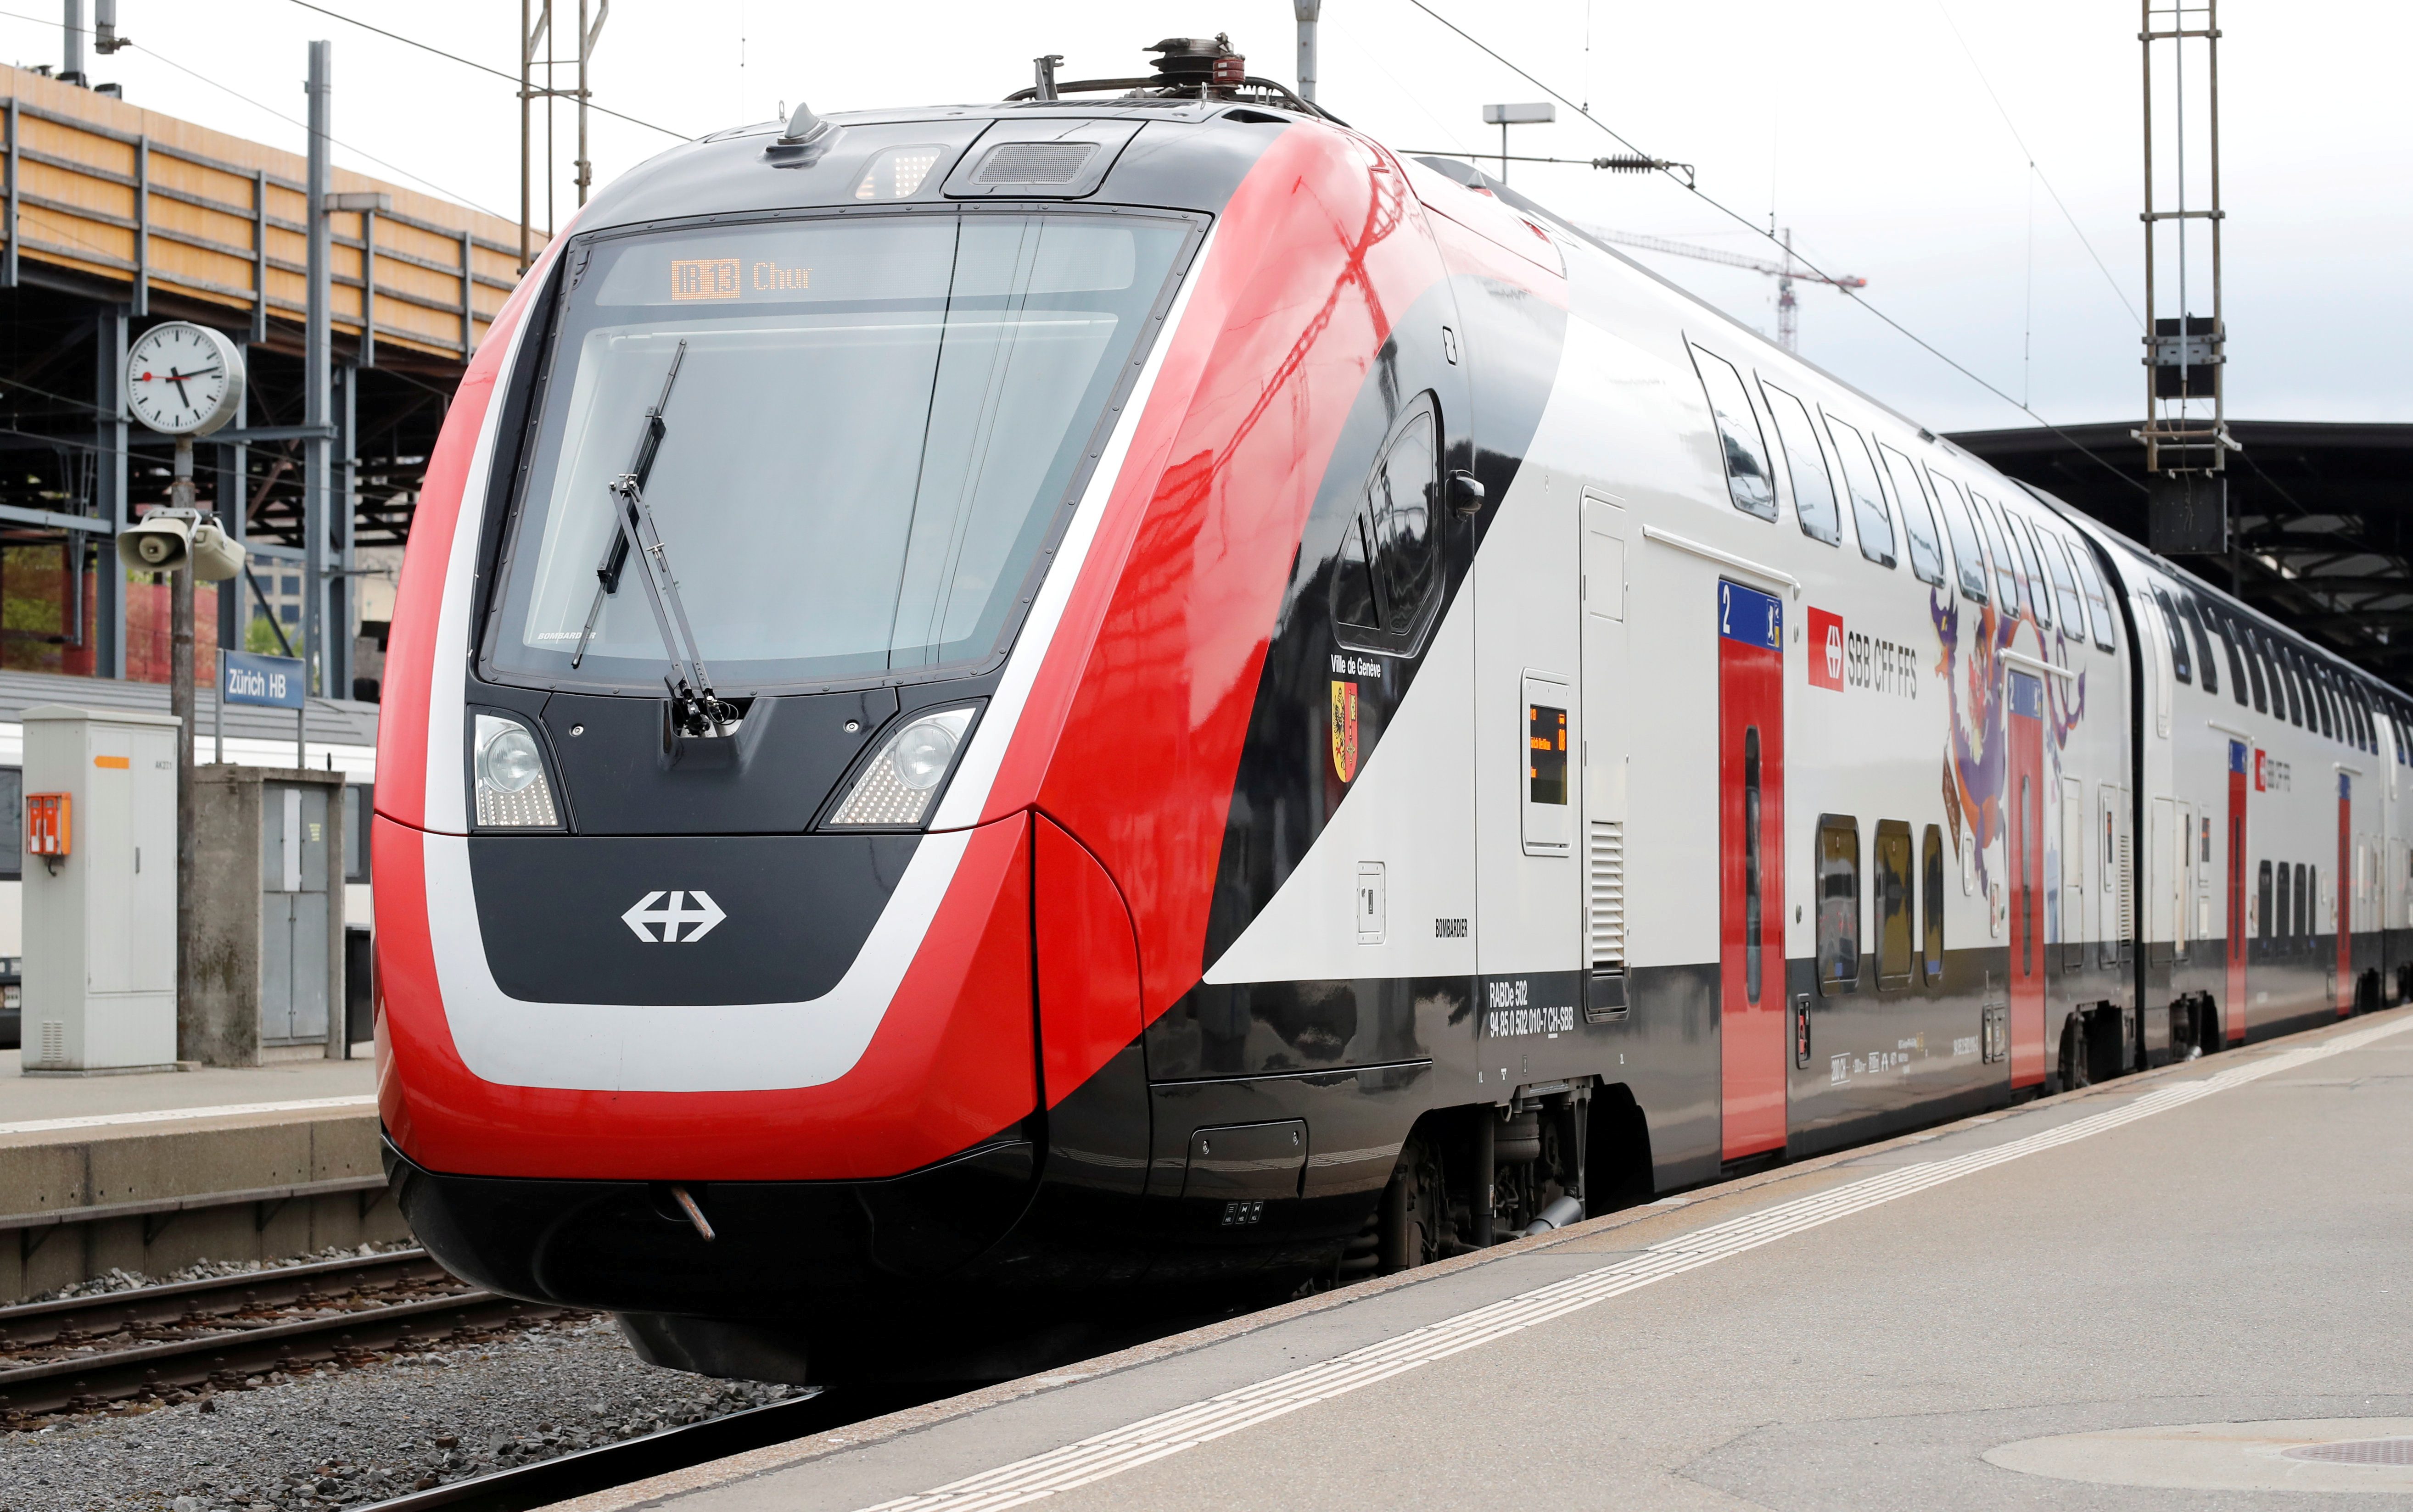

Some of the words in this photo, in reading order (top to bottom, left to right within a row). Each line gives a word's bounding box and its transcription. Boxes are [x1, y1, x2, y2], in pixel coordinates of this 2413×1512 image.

[678, 264, 700, 293] IR
[711, 262, 735, 292] 13
[754, 262, 813, 290] Chur
[1723, 585, 1730, 634] 2
[1331, 654, 1346, 674] Ville
[1347, 656, 1356, 675] de
[1357, 657, 1381, 678] Genève
[1848, 630, 1870, 688] SBB
[1875, 638, 1894, 693] CFF
[1898, 645, 1916, 700] FFS
[229, 668, 265, 697] Zürich
[269, 673, 286, 699] HB
[2010, 675, 2015, 710] 2
[1436, 918, 1467, 937] BOMBARDIER
[1489, 982, 1514, 1008] RABDe
[1515, 980, 1528, 1006] 502
[1490, 1011, 1499, 1038] 94
[1500, 1010, 1508, 1037] 85
[1510, 1010, 1514, 1036] 0
[1516, 1009, 1528, 1035] 502
[1529, 1008, 1547, 1034] 010-7
[1548, 1006, 1573, 1032] CH-SBB
